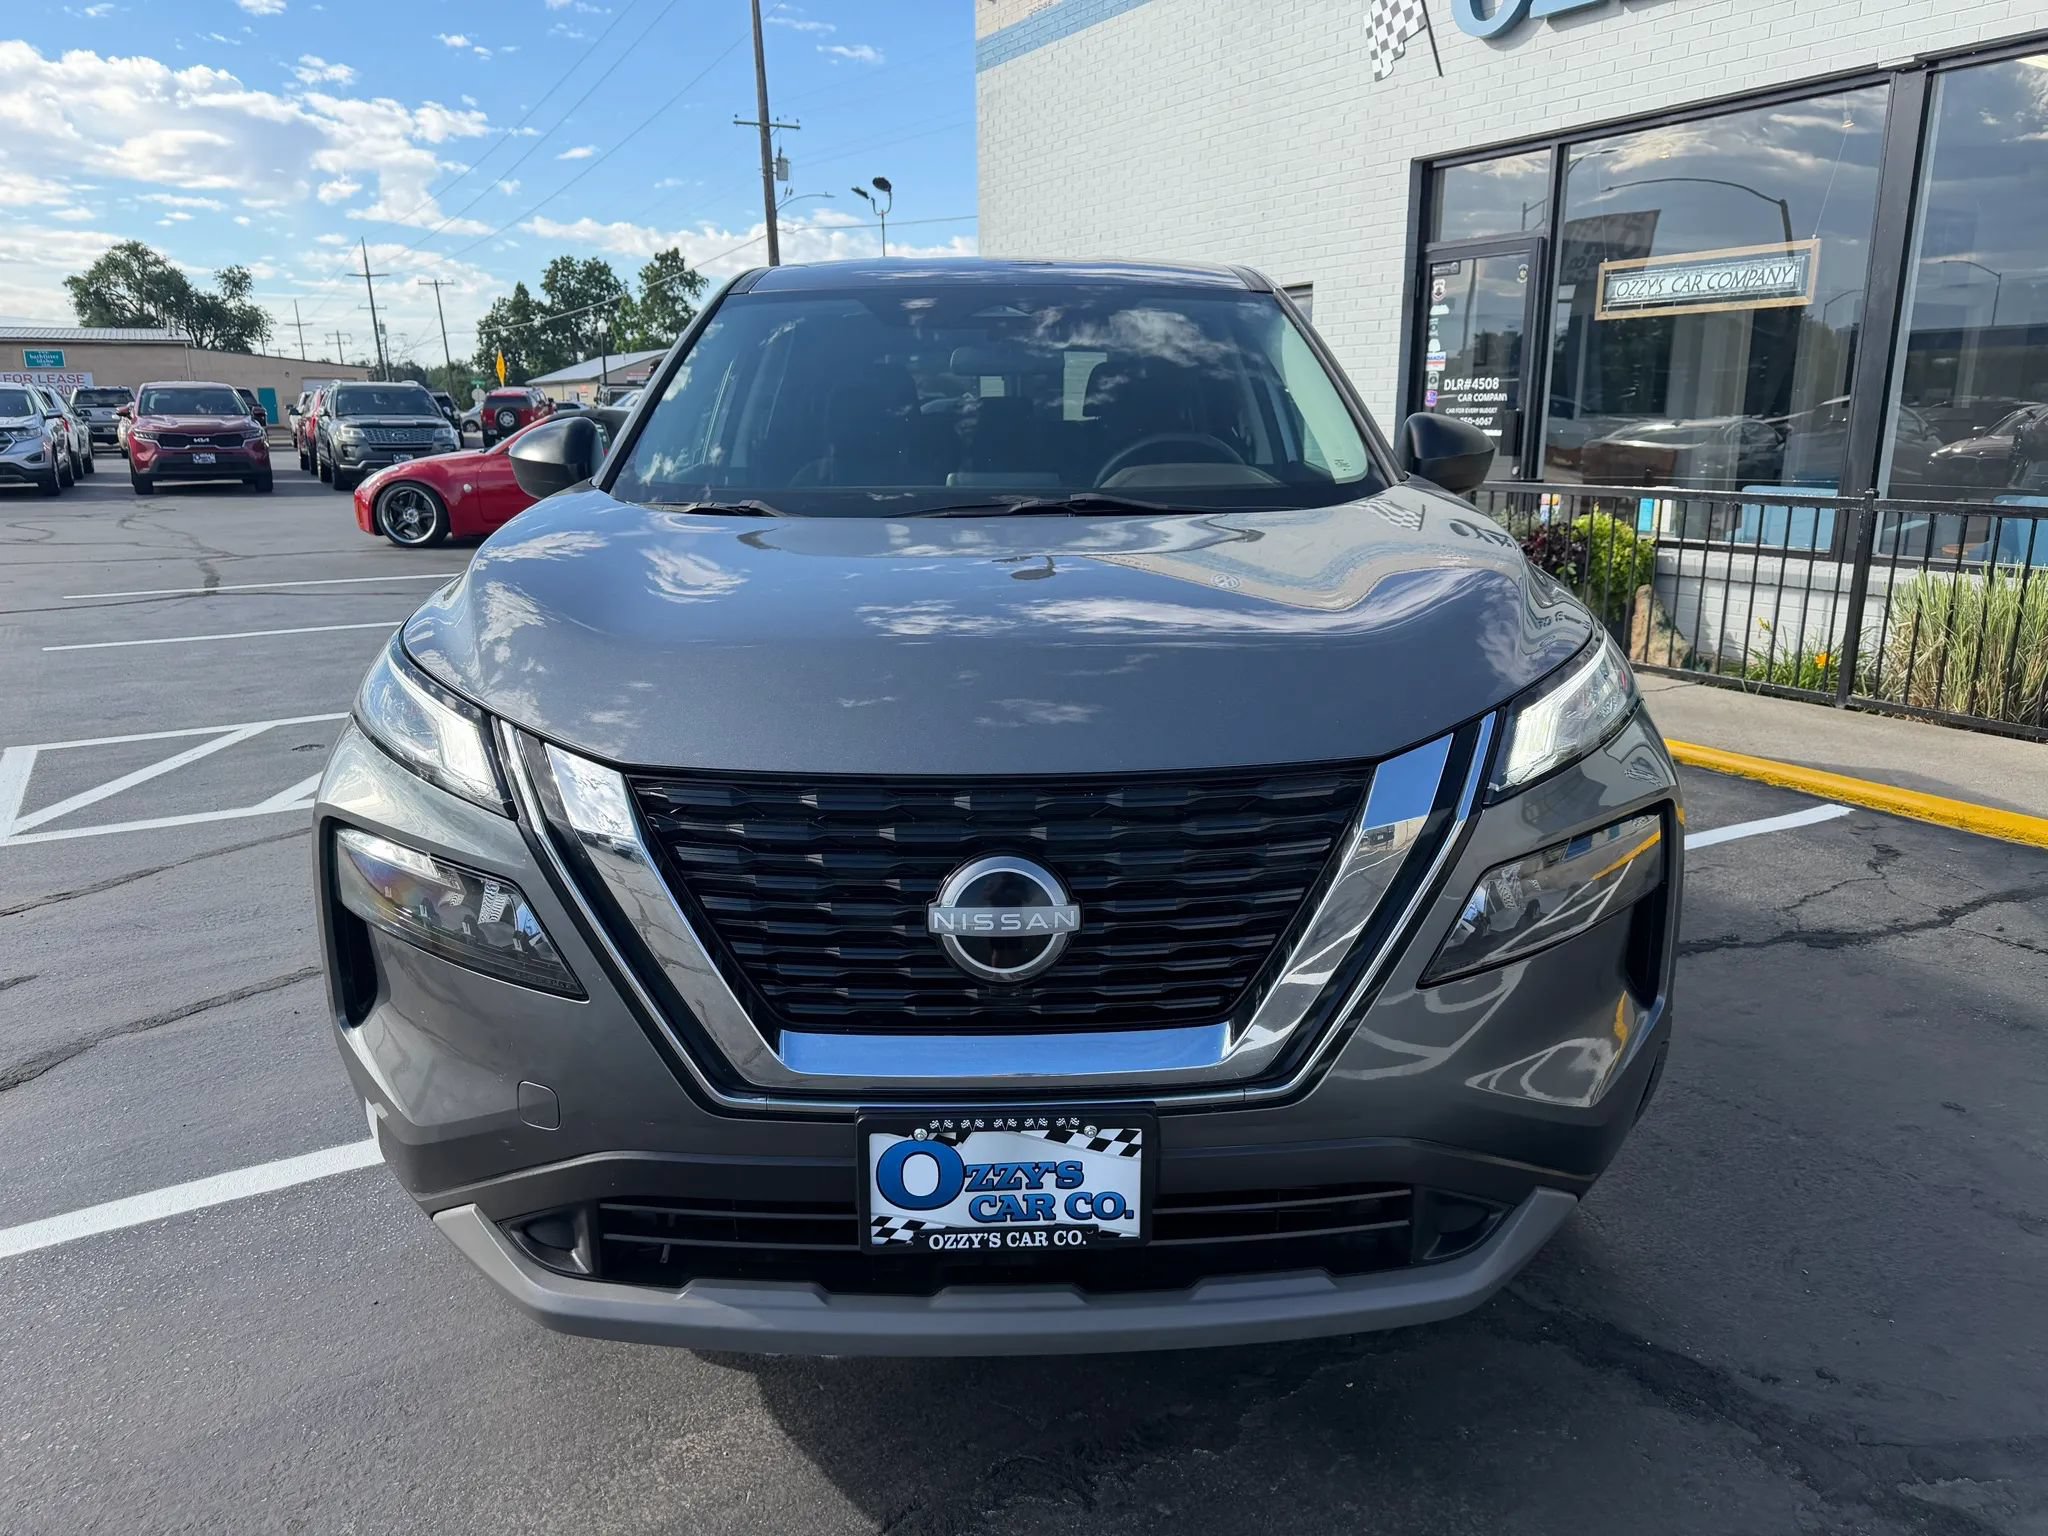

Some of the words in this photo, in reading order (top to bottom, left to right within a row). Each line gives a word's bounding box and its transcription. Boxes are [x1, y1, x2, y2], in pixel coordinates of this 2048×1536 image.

[1616, 277, 1666, 298] OZZY'S
[1671, 273, 1702, 294] CAR
[1707, 265, 1794, 289] COMPANY
[3, 373, 33, 384] FOR
[38, 373, 85, 384] LEASE
[1443, 377, 1499, 391] DLR#4508
[1457, 393, 1472, 402] CAR
[933, 910, 1075, 931] NISSAN
[968, 1192, 1056, 1223] CAR
[1064, 1191, 1134, 1220] CO.
[928, 1231, 1001, 1250] OZZY'S
[1006, 1230, 1049, 1247] CAR
[1053, 1229, 1087, 1246] CO.
